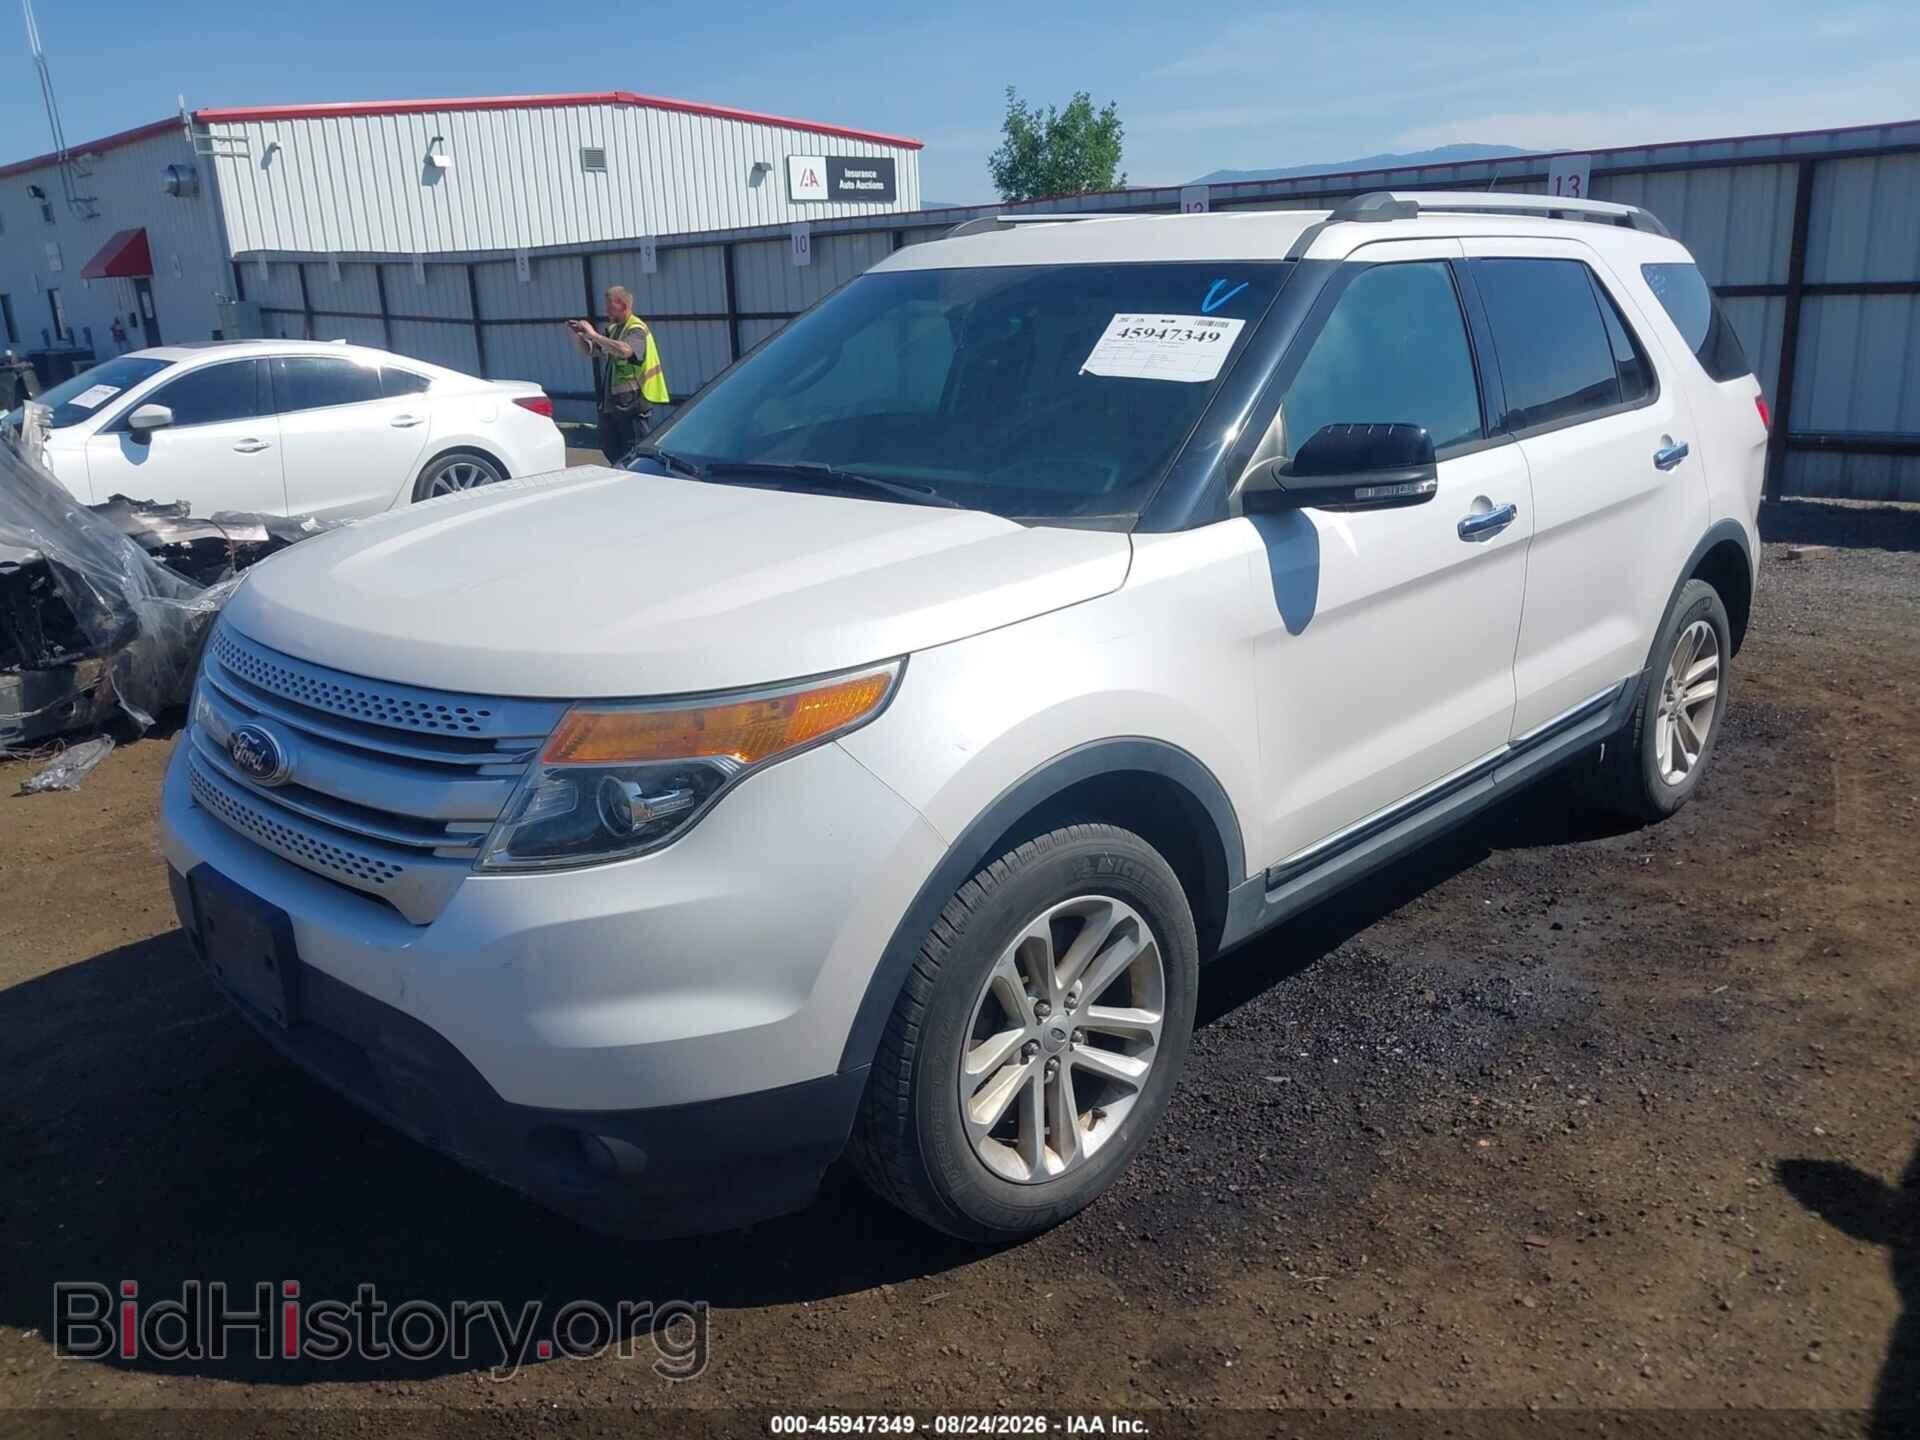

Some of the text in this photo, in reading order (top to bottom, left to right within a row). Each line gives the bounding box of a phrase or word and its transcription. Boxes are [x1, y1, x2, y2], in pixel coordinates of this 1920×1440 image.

[845, 168, 877, 179] Insurance
[839, 179, 885, 191] Auto Auctions
[1556, 174, 1581, 198] 13
[794, 234, 807, 254] 10
[1117, 327, 1222, 343] 45947349
[232, 731, 266, 771] Ford
